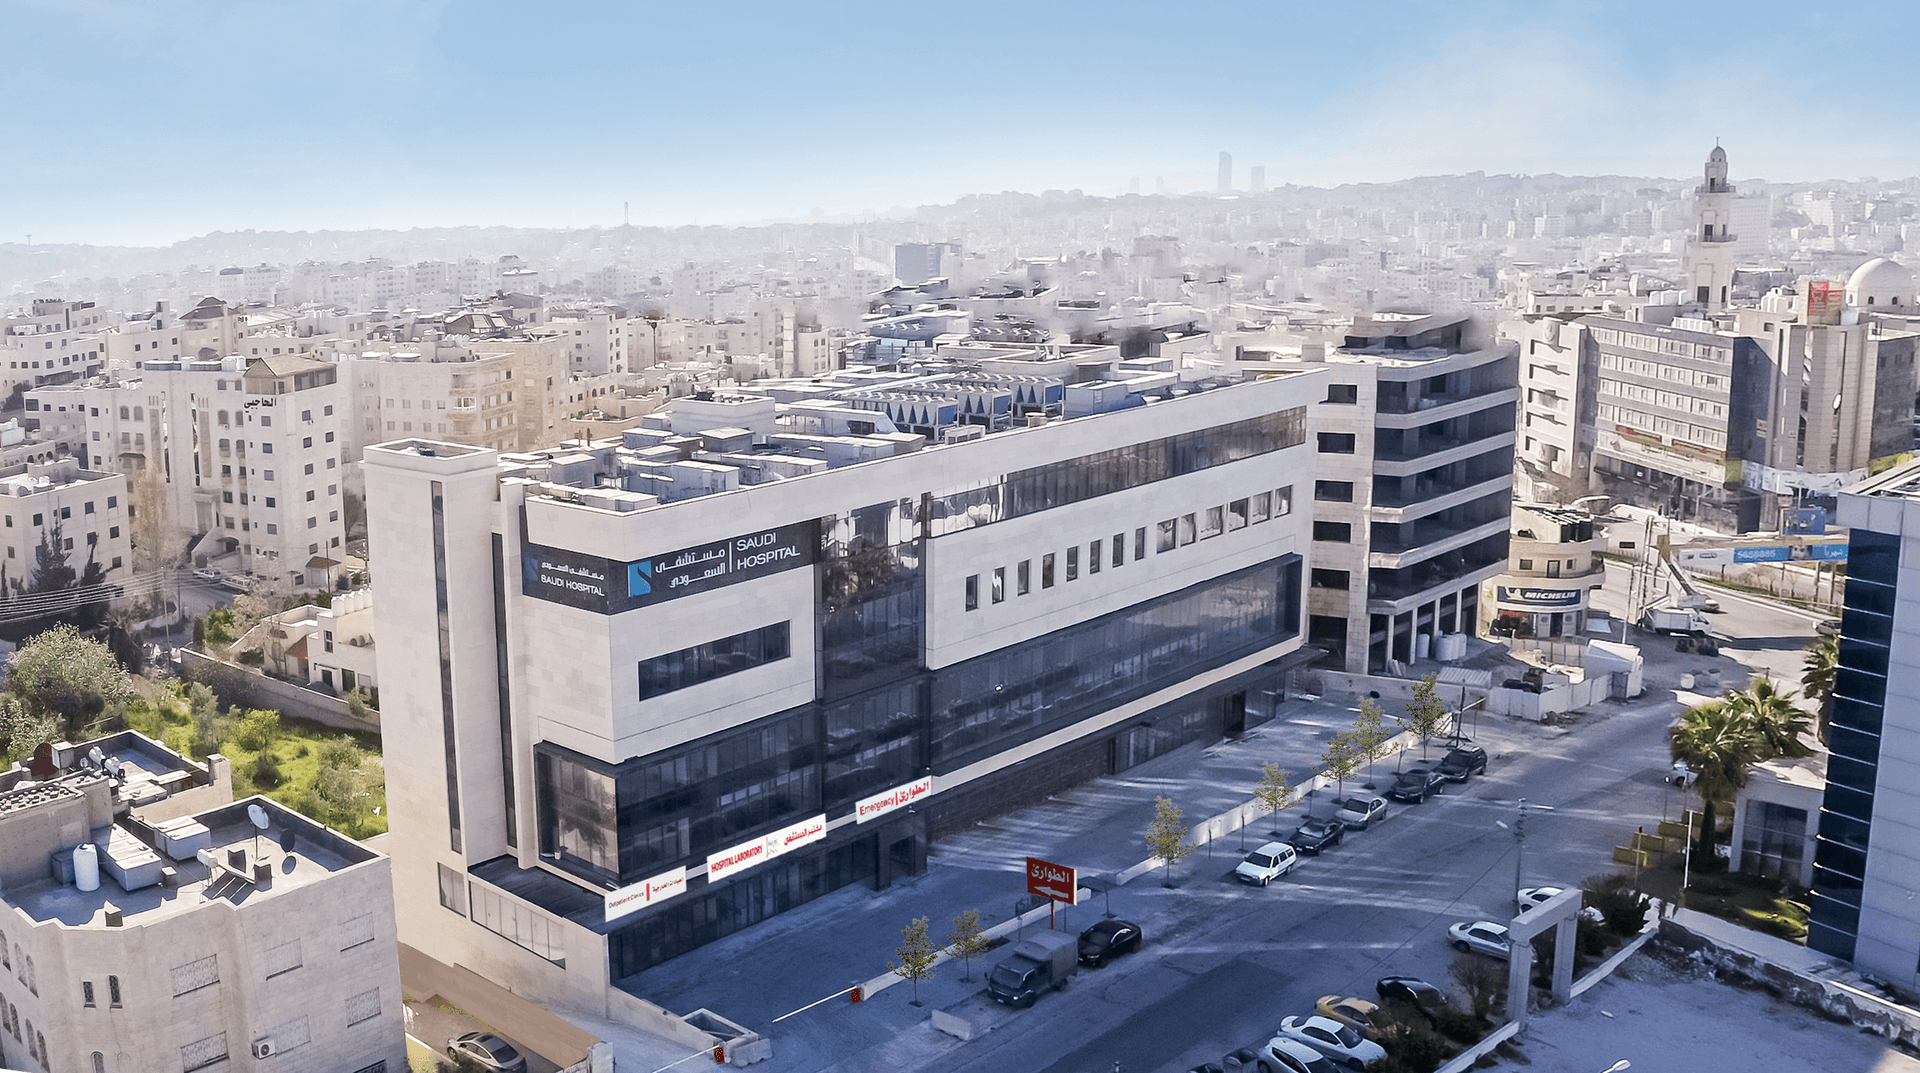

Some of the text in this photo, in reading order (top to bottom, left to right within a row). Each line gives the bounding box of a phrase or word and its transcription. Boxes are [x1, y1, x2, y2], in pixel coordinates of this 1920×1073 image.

[737, 532, 776, 551] SAUDI
[655, 549, 726, 573] مستشفى
[737, 546, 801, 570] HOSPITAL
[541, 574, 605, 597] SAUDI HOSPITAL
[669, 563, 726, 588] السعودي
[1524, 591, 1577, 600] MICHELIN
[899, 781, 929, 803] الطوارئ
[860, 796, 894, 815] Emergency
[711, 856, 734, 873] HOSPITAL
[734, 845, 763, 864] LABORATORY
[1031, 864, 1070, 883] الطوارئ
[608, 892, 645, 909] Outpatient Clinics
